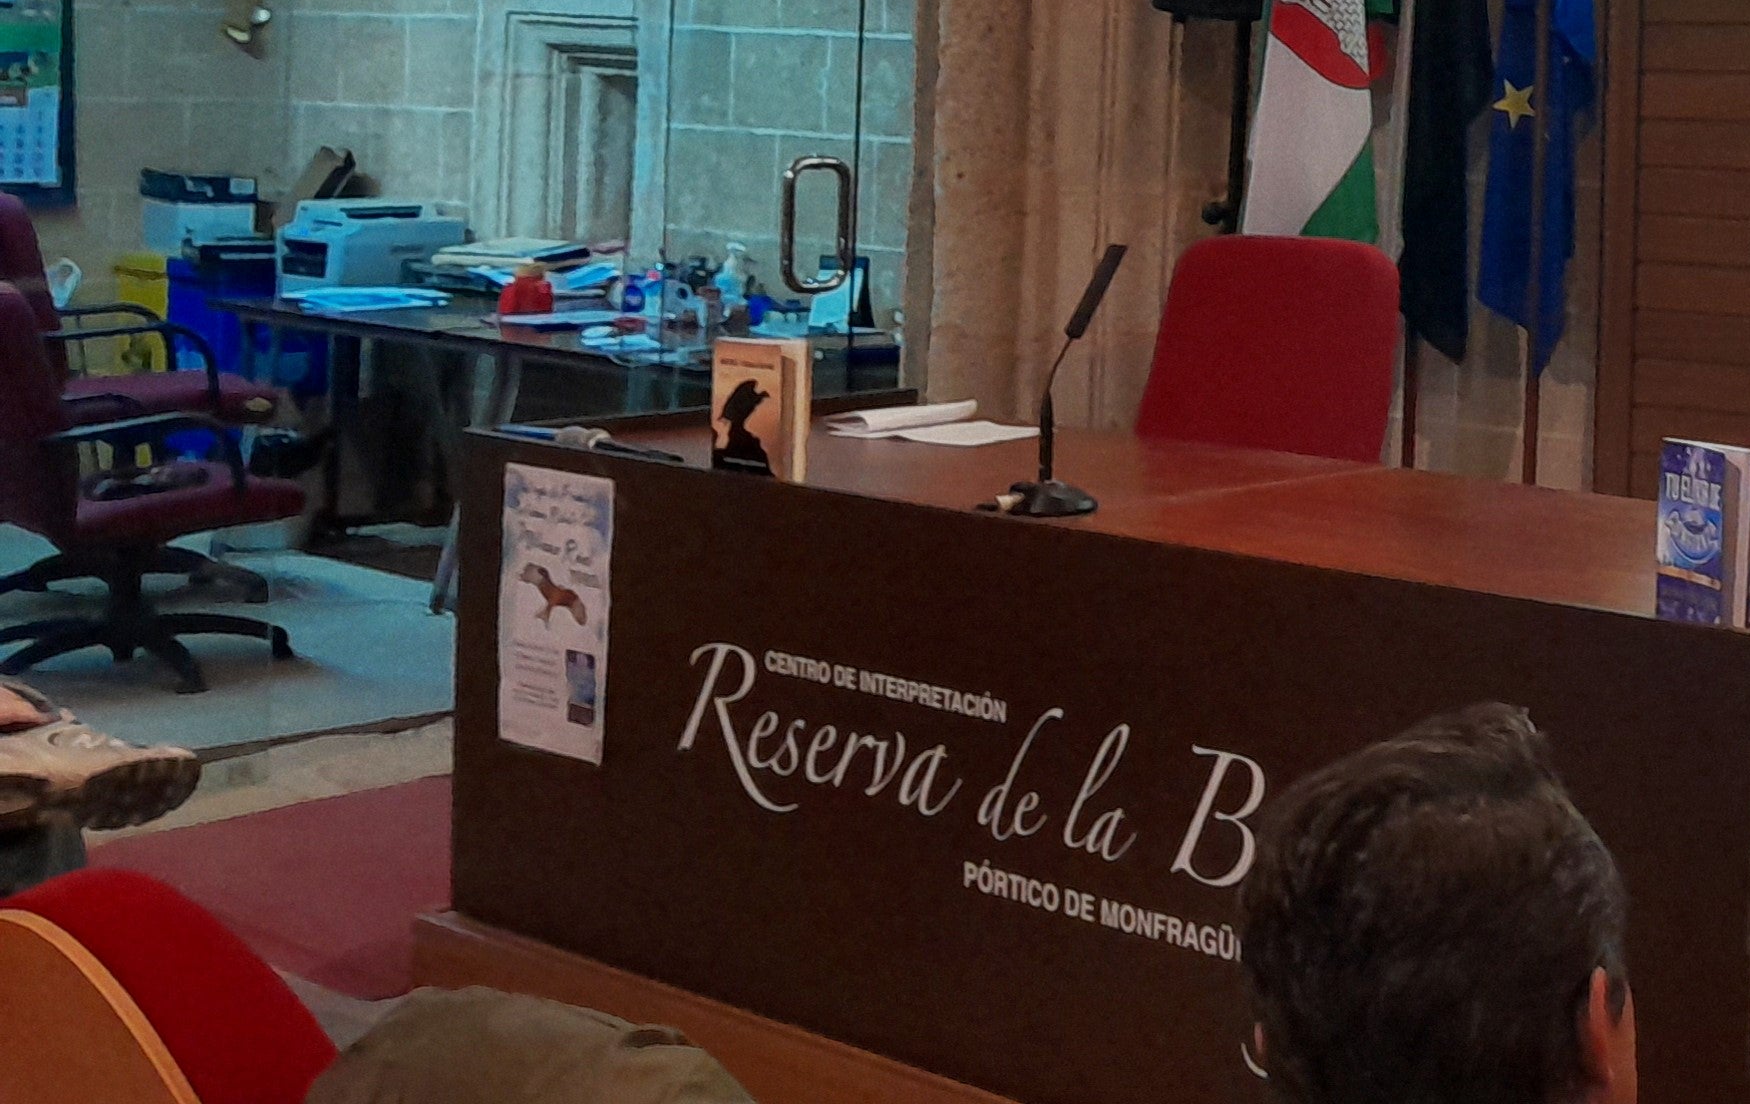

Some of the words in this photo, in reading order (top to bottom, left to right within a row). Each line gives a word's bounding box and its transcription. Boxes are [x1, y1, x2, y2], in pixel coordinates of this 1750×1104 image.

[764, 649, 832, 684] CENTRO
[833, 663, 857, 691] DE
[859, 670, 1007, 723] INTERPRETACIÓN
[677, 641, 962, 817] Reserva
[977, 707, 1064, 842] de
[1063, 723, 1137, 863] la
[963, 858, 1060, 913] PÓRTICO
[1064, 887, 1096, 923] DE
